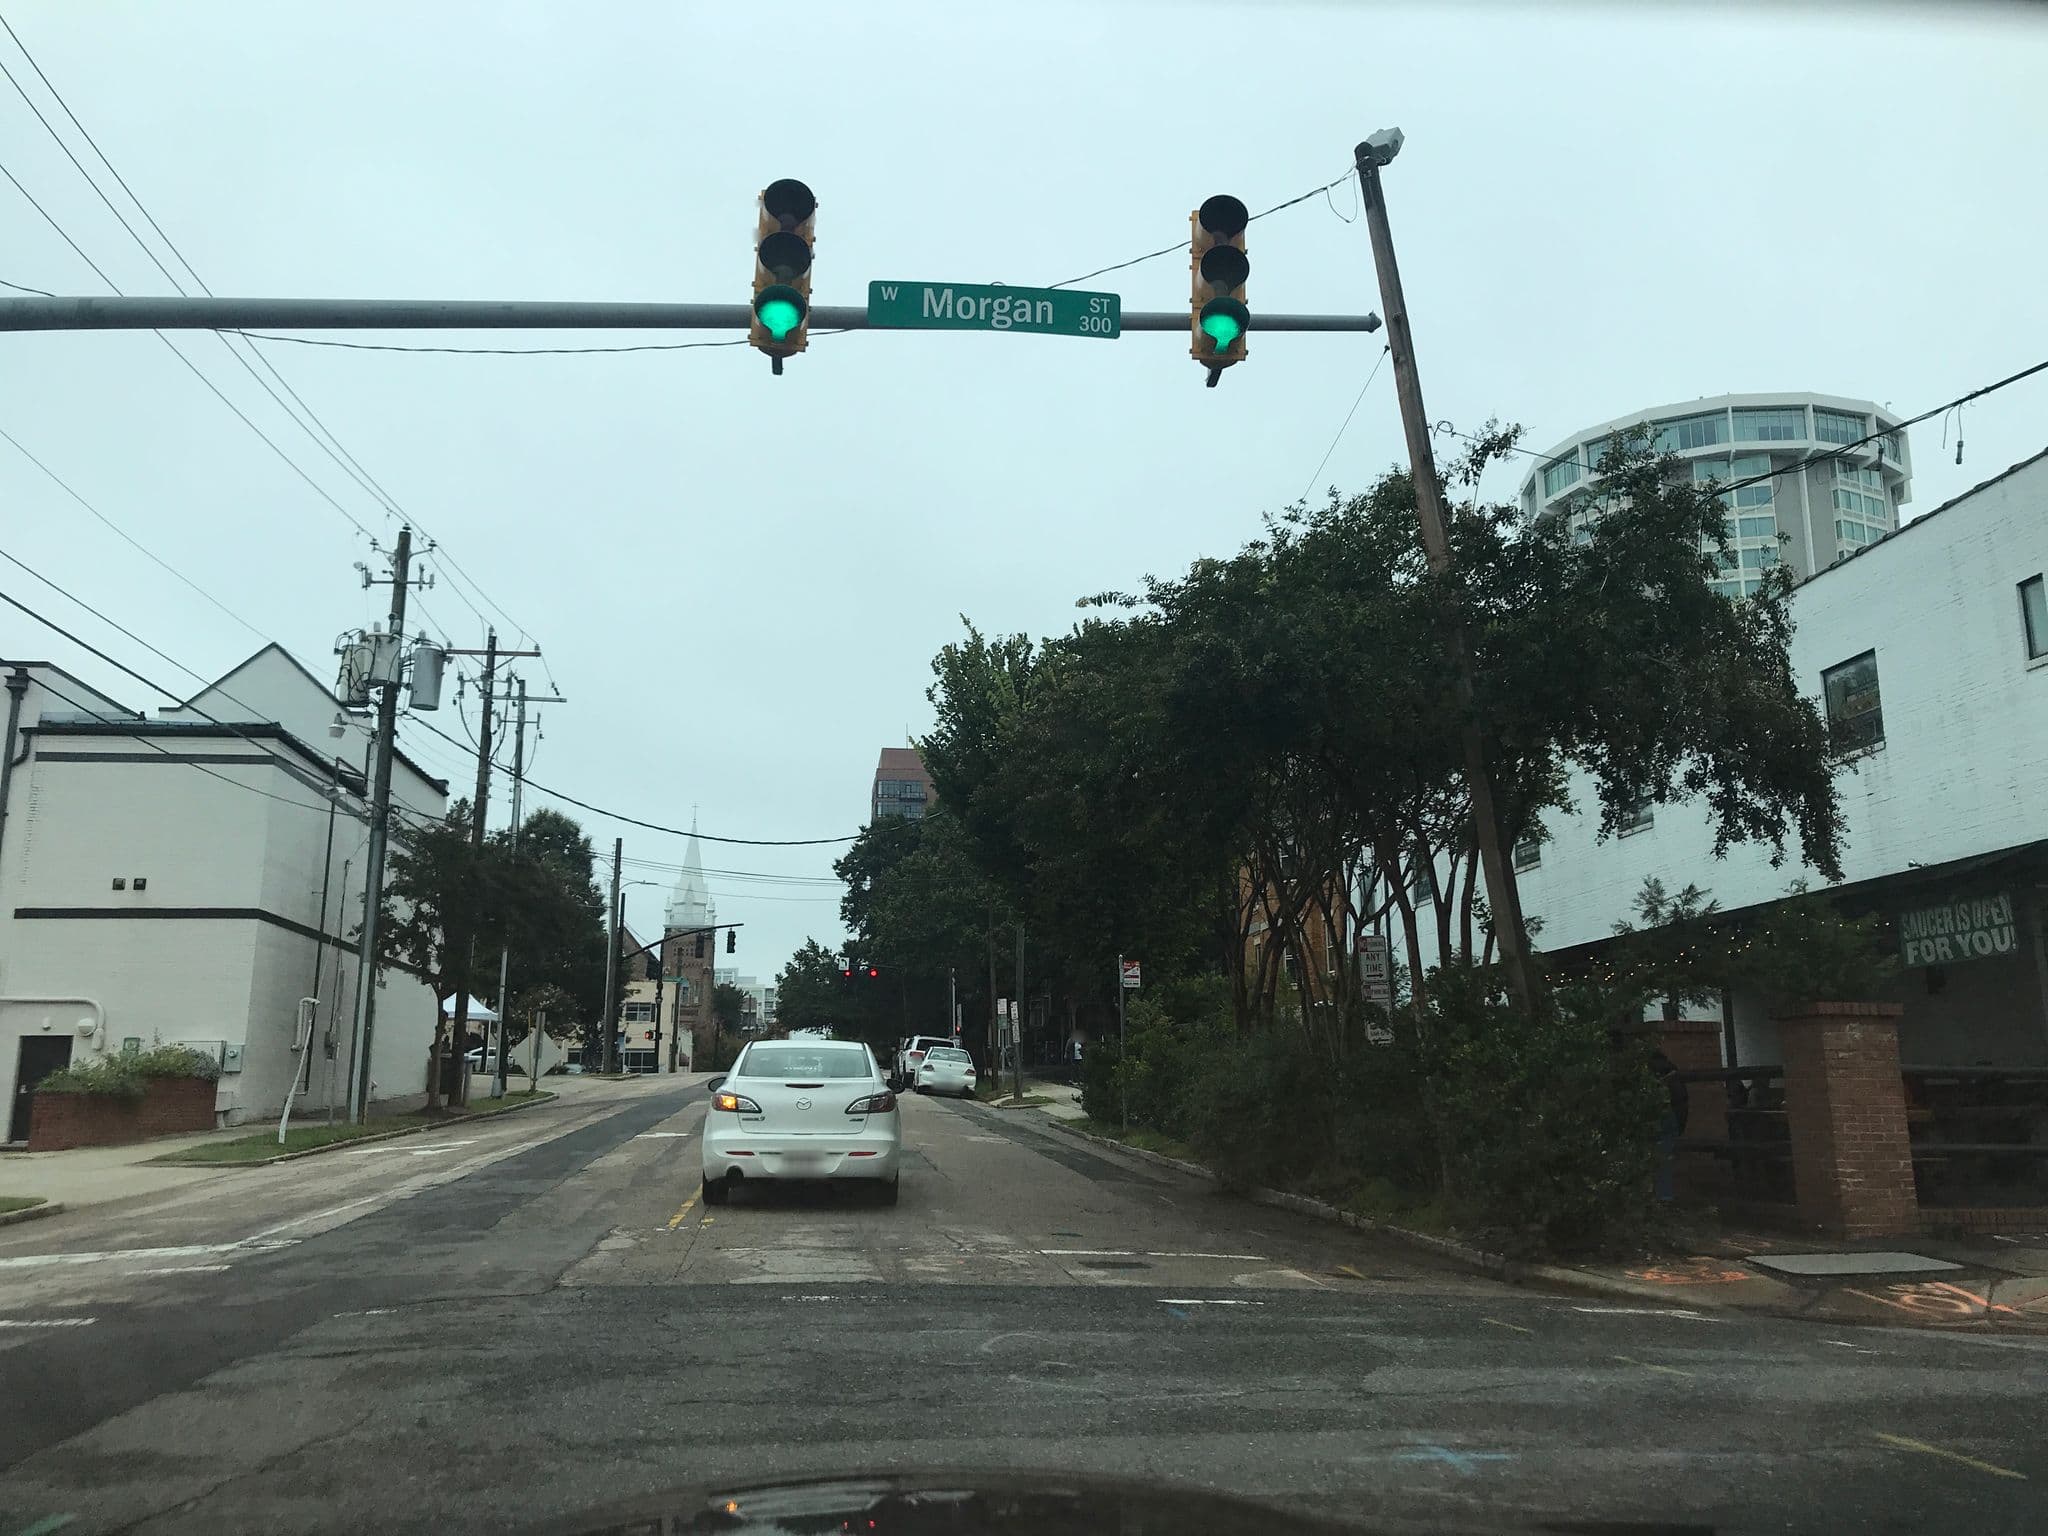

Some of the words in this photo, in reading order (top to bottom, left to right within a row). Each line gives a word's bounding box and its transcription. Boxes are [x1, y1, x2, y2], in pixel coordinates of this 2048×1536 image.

[881, 286, 899, 301] W
[922, 287, 1054, 329] Morgan
[1089, 297, 1111, 314] ST
[1079, 316, 1112, 333] 300
[1902, 907, 1954, 939] SAUCER
[1956, 903, 1971, 932] IS
[1972, 895, 2013, 928] OPEN
[1366, 953, 1380, 961] ANY
[1906, 936, 1954, 965] FOR
[1955, 925, 2017, 957] YOU!
[1366, 964, 1383, 972] TIME
